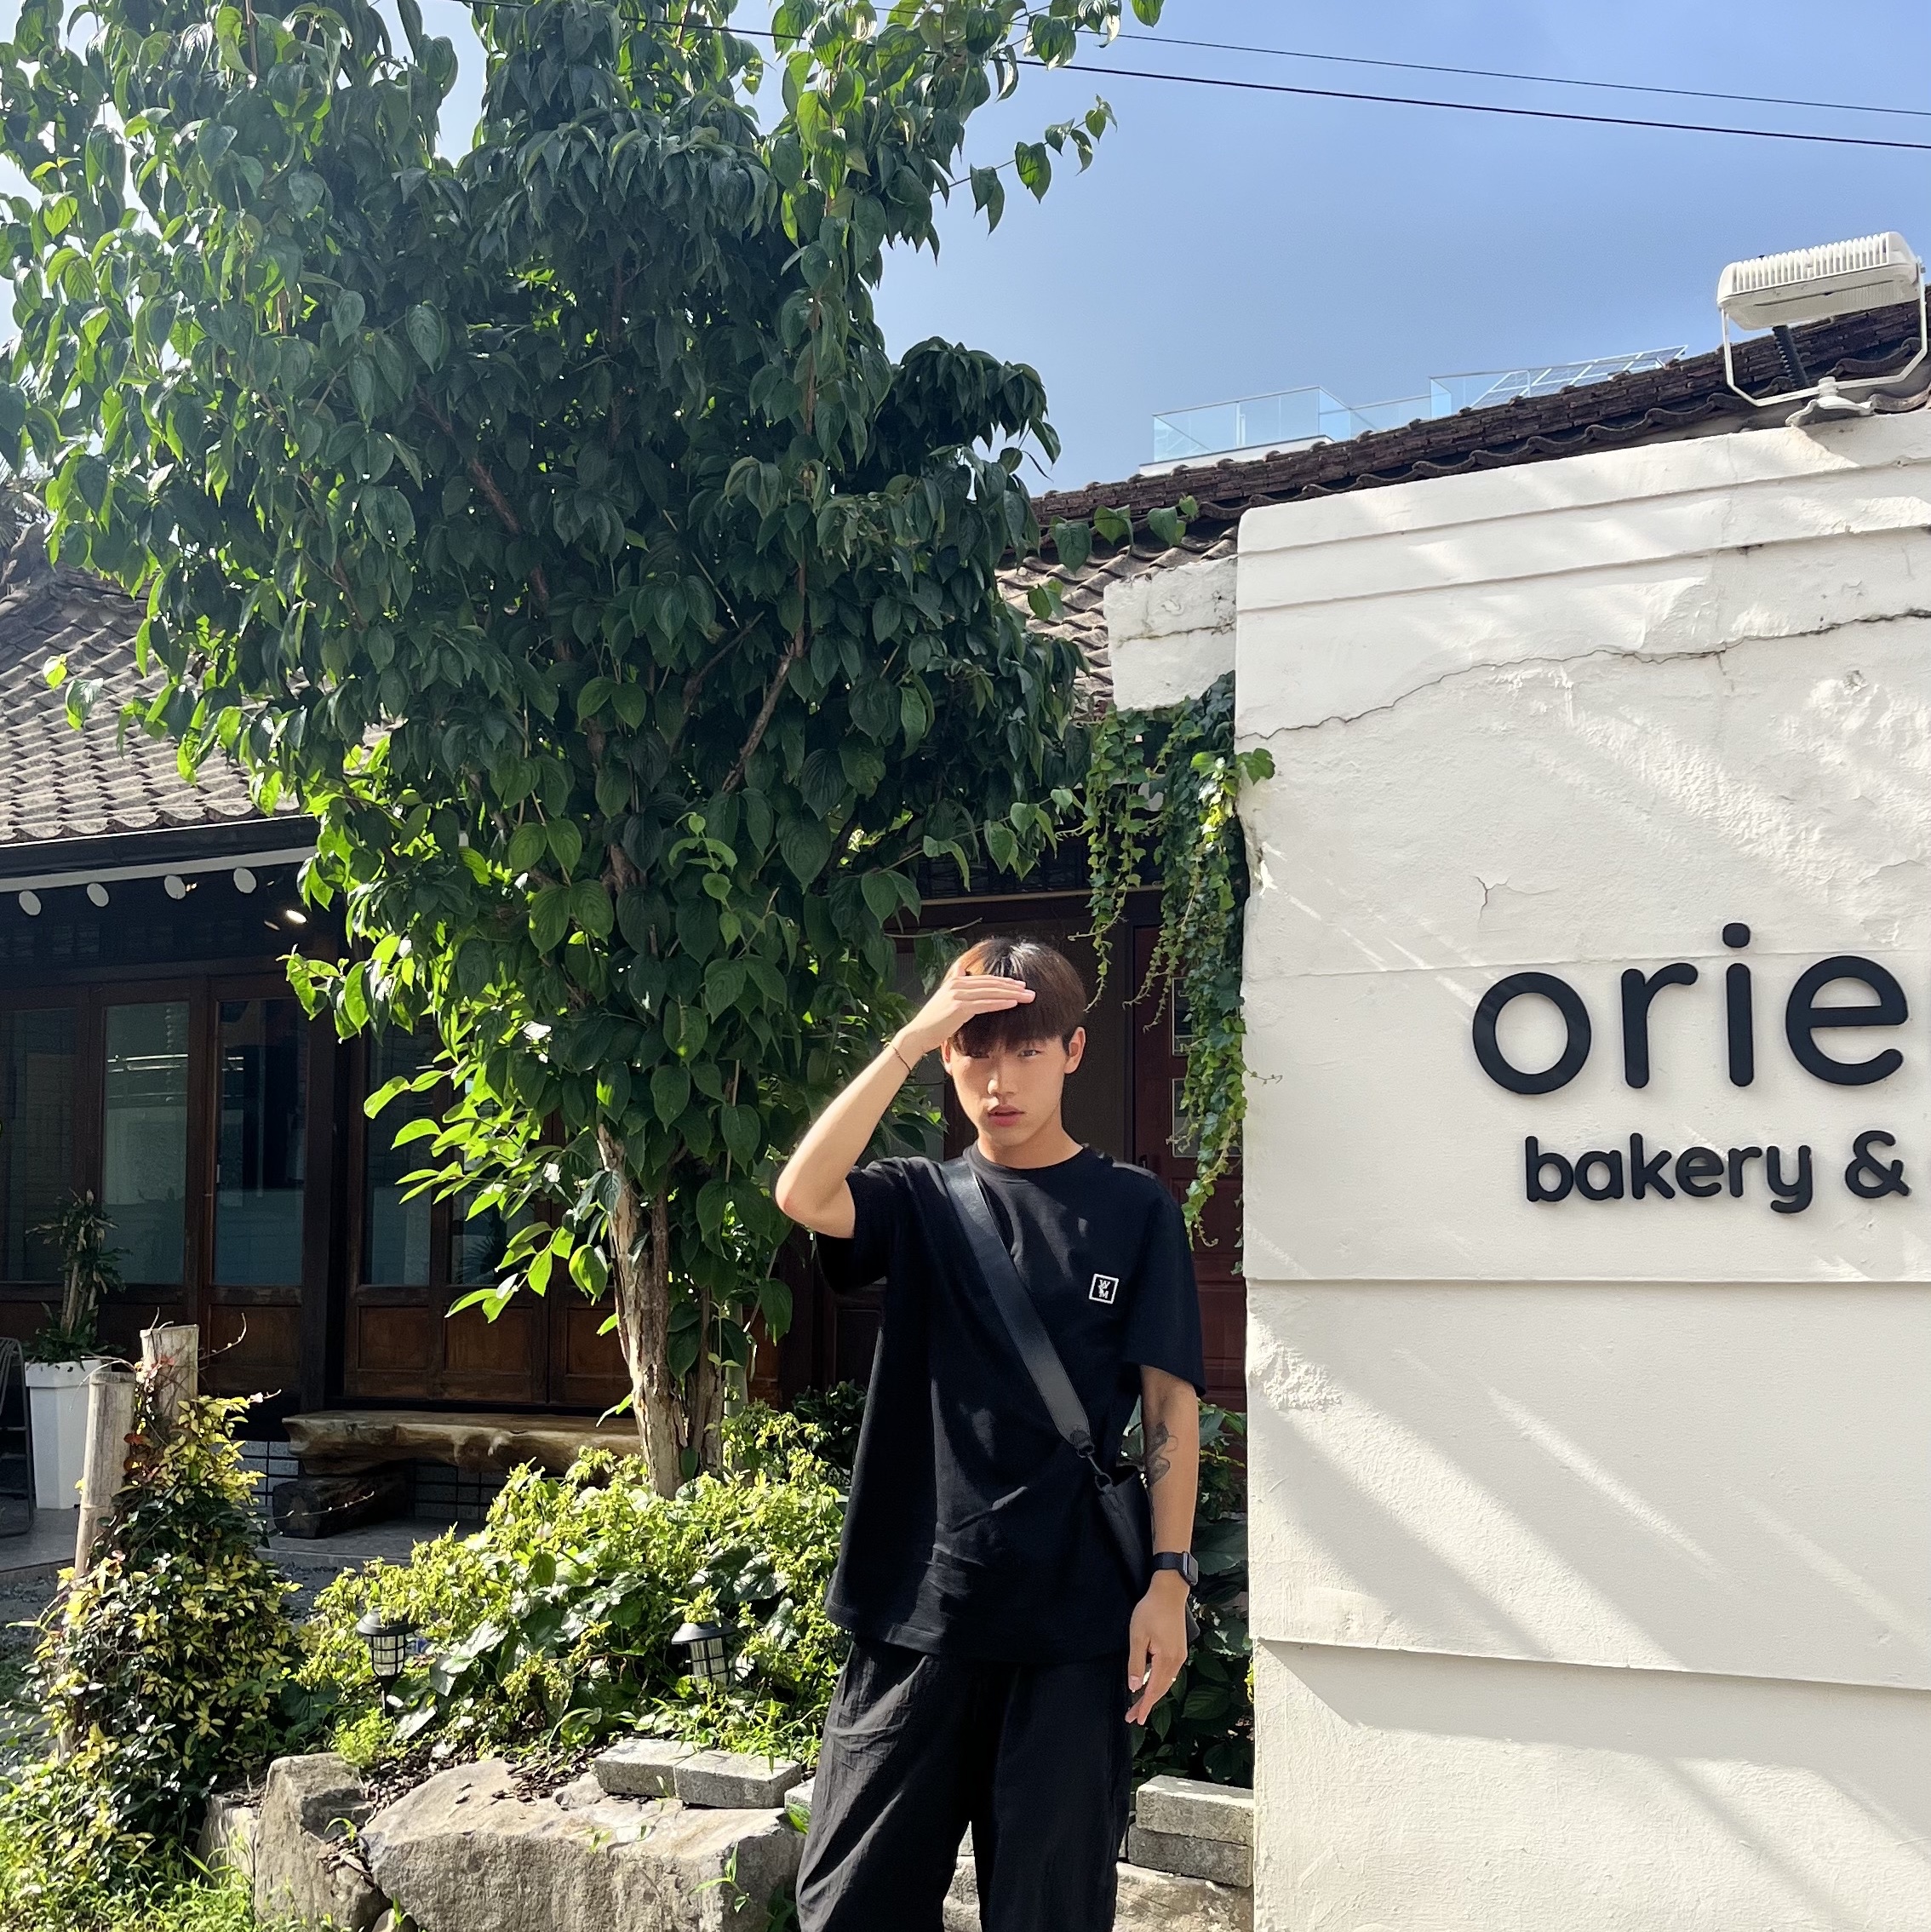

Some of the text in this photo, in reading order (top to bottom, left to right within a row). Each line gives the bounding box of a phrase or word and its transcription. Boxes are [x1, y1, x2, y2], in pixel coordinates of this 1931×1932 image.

[1472, 922, 1909, 1096] orie
[1525, 1130, 1911, 1214] bakery &
